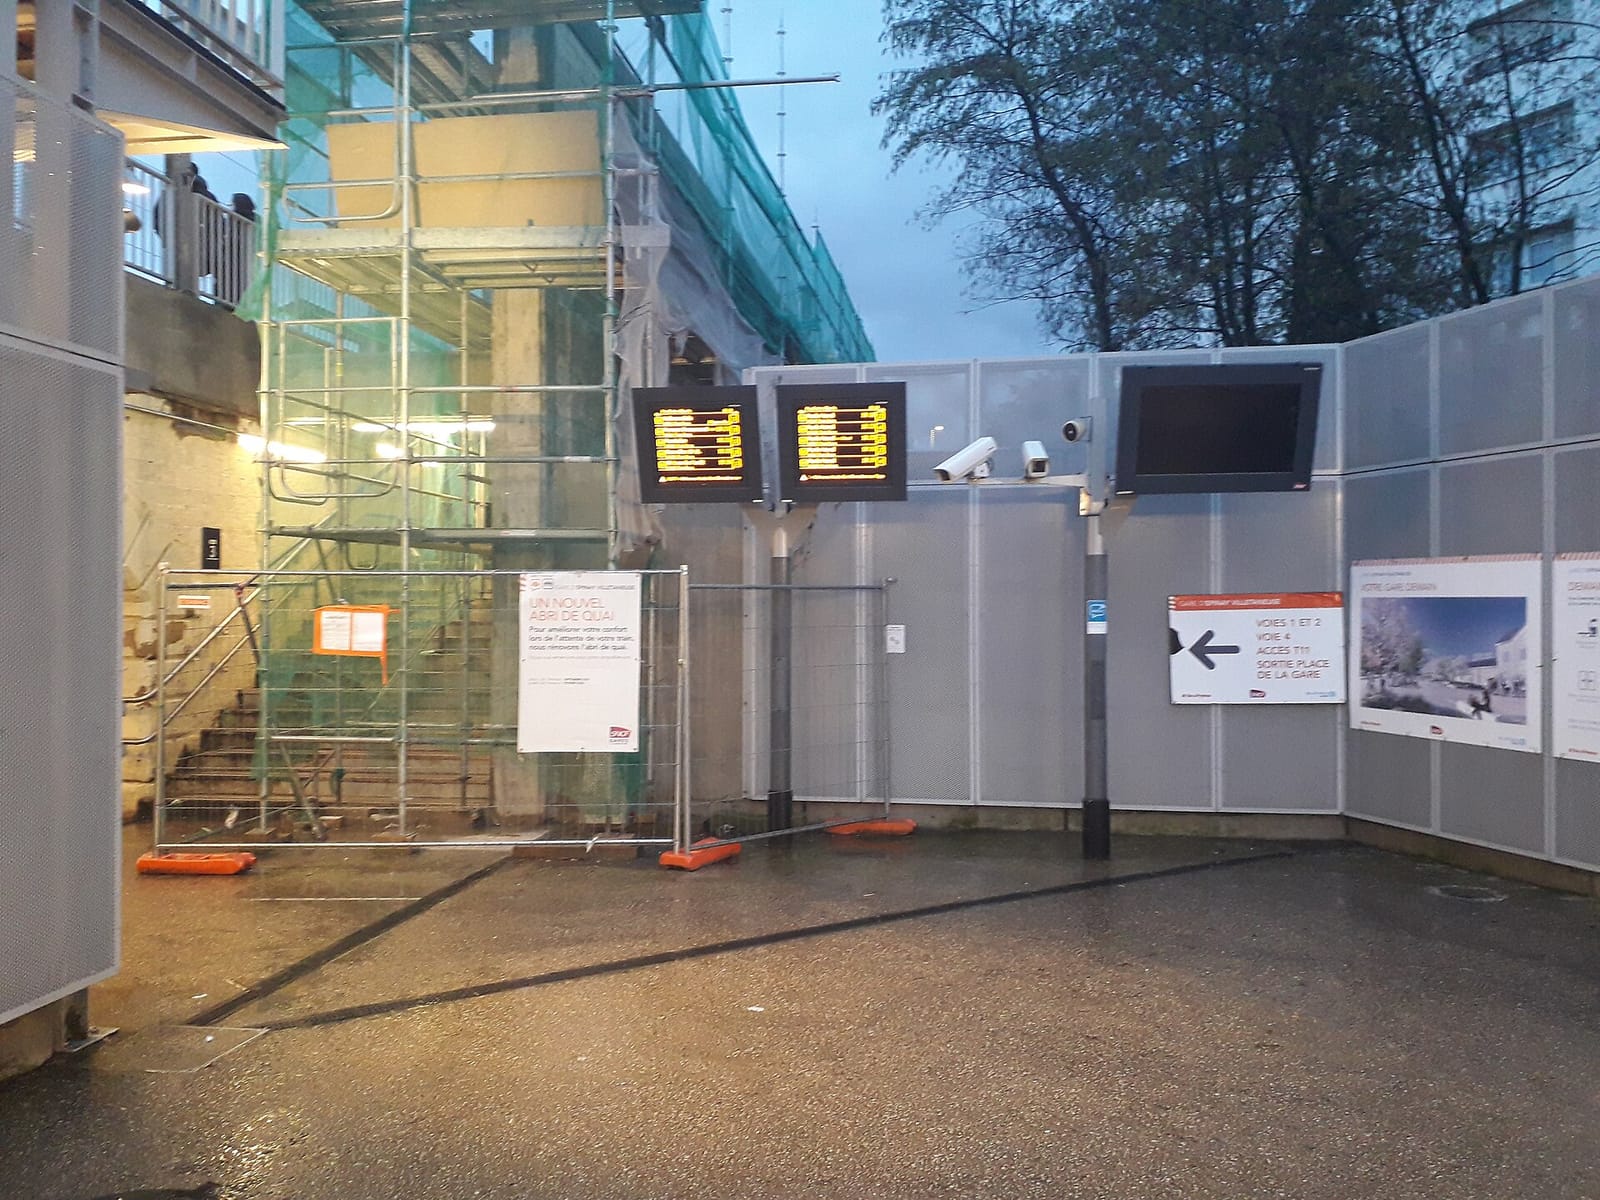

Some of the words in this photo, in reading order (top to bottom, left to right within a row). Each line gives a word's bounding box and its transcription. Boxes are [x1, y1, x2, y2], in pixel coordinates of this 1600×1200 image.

[529, 597, 551, 609] UN
[552, 597, 606, 609] NOUVEL
[529, 610, 558, 621] ABRI
[561, 610, 579, 621] DE
[582, 610, 615, 622] QUAI
[1256, 618, 1287, 628] VOIES
[1290, 618, 1296, 628] 1
[1298, 618, 1312, 628] ET
[1315, 618, 1322, 628] 2
[602, 625, 629, 633] confort
[1256, 632, 1282, 642] VOIE
[1285, 632, 1292, 640] 4
[1293, 646, 1312, 654] T11
[1256, 659, 1294, 668] SORTIE
[1297, 659, 1330, 668] PLACE
[1257, 670, 1273, 680] DE
[1275, 670, 1290, 680] LA
[1292, 670, 1322, 680] GARE
